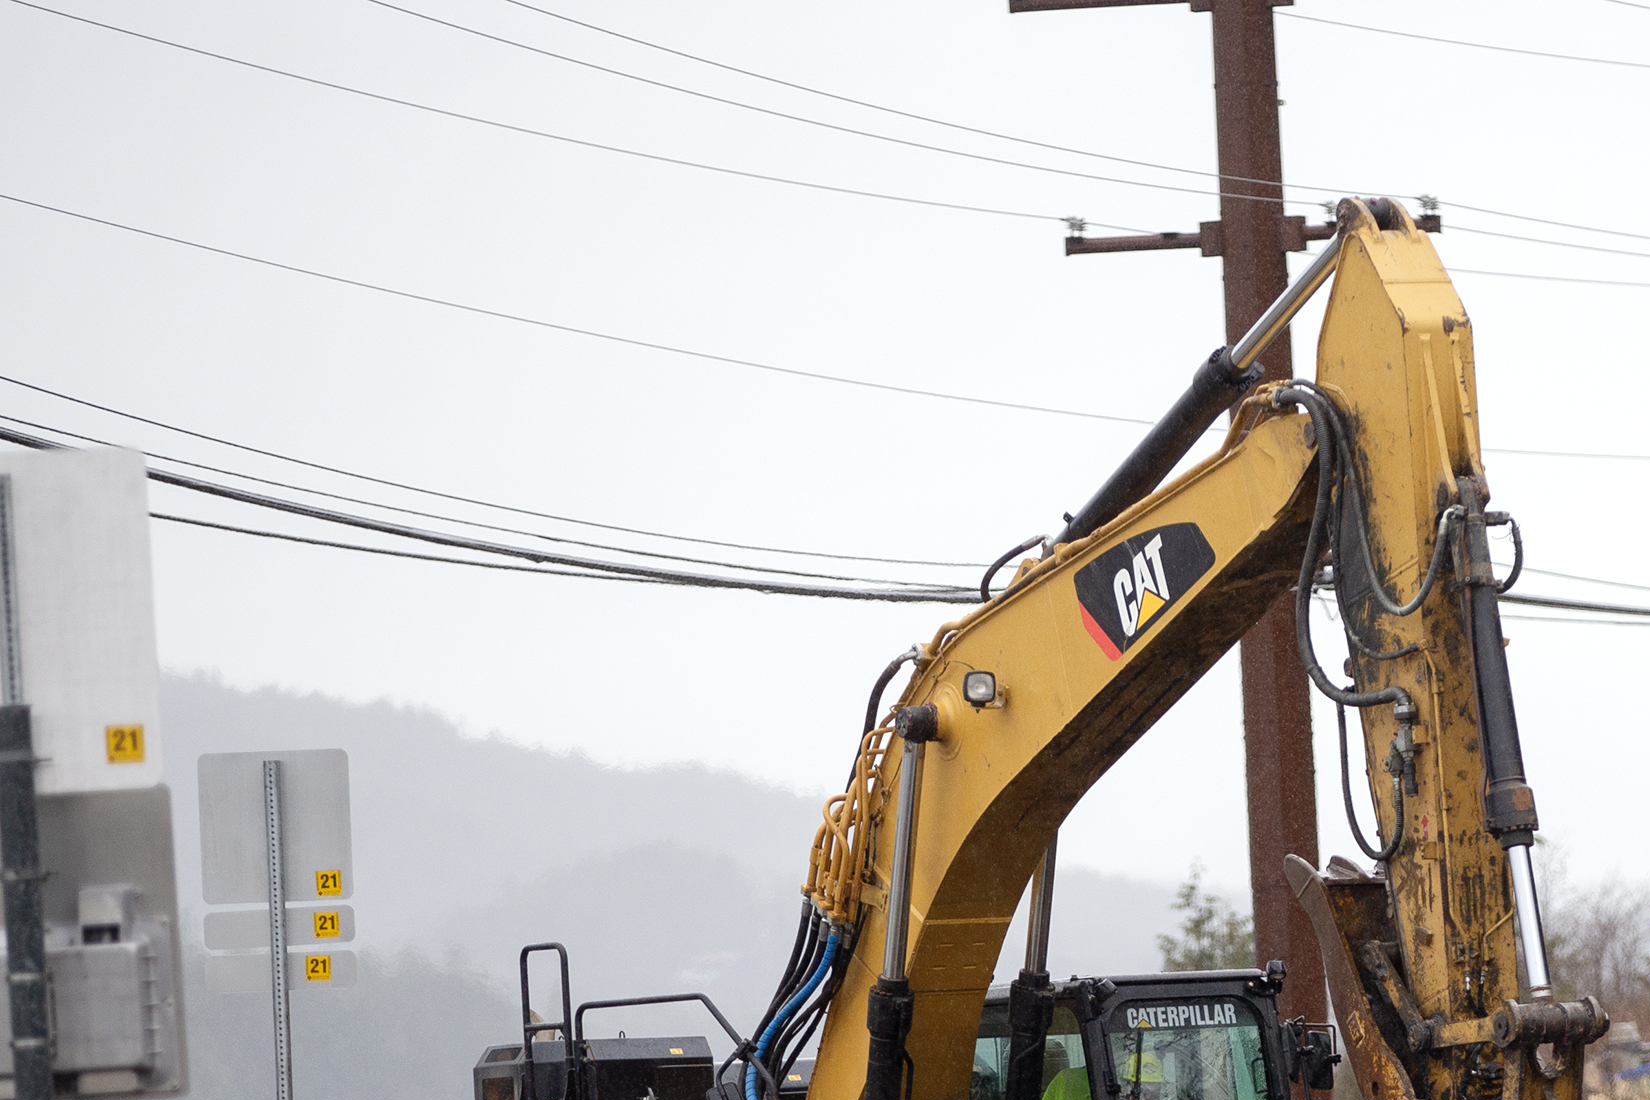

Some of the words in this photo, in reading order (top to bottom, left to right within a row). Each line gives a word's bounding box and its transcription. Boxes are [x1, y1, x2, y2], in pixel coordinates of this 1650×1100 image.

[1113, 533, 1170, 637] CAT
[112, 729, 138, 752] 21
[320, 873, 338, 889] 21
[318, 915, 336, 931] 21
[309, 959, 328, 974] 21
[1126, 1003, 1237, 1029] CATERPILLAR
